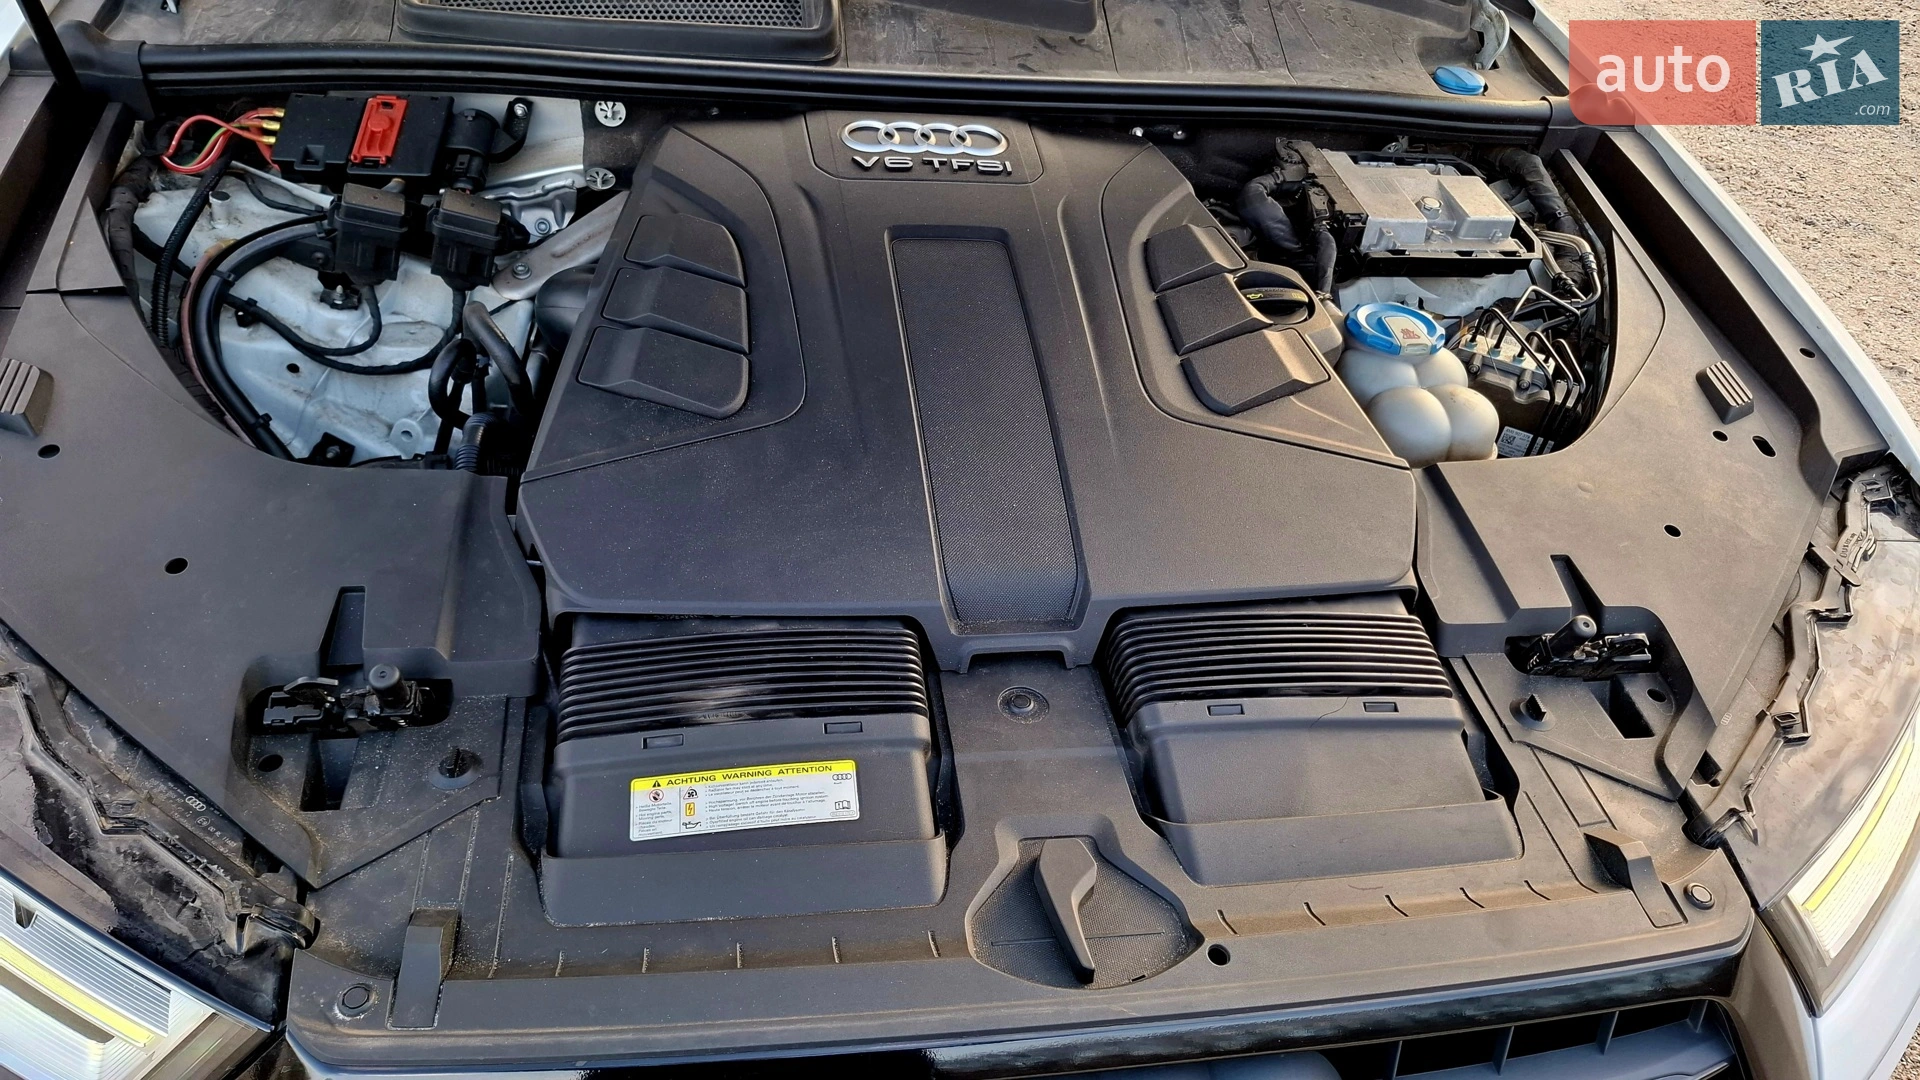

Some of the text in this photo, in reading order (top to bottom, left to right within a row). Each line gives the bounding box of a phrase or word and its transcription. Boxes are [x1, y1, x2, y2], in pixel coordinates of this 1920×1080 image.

[851, 155, 1013, 176] V6 TFSI
[667, 765, 832, 786] ACHTUNG WARNING ATTENTION
